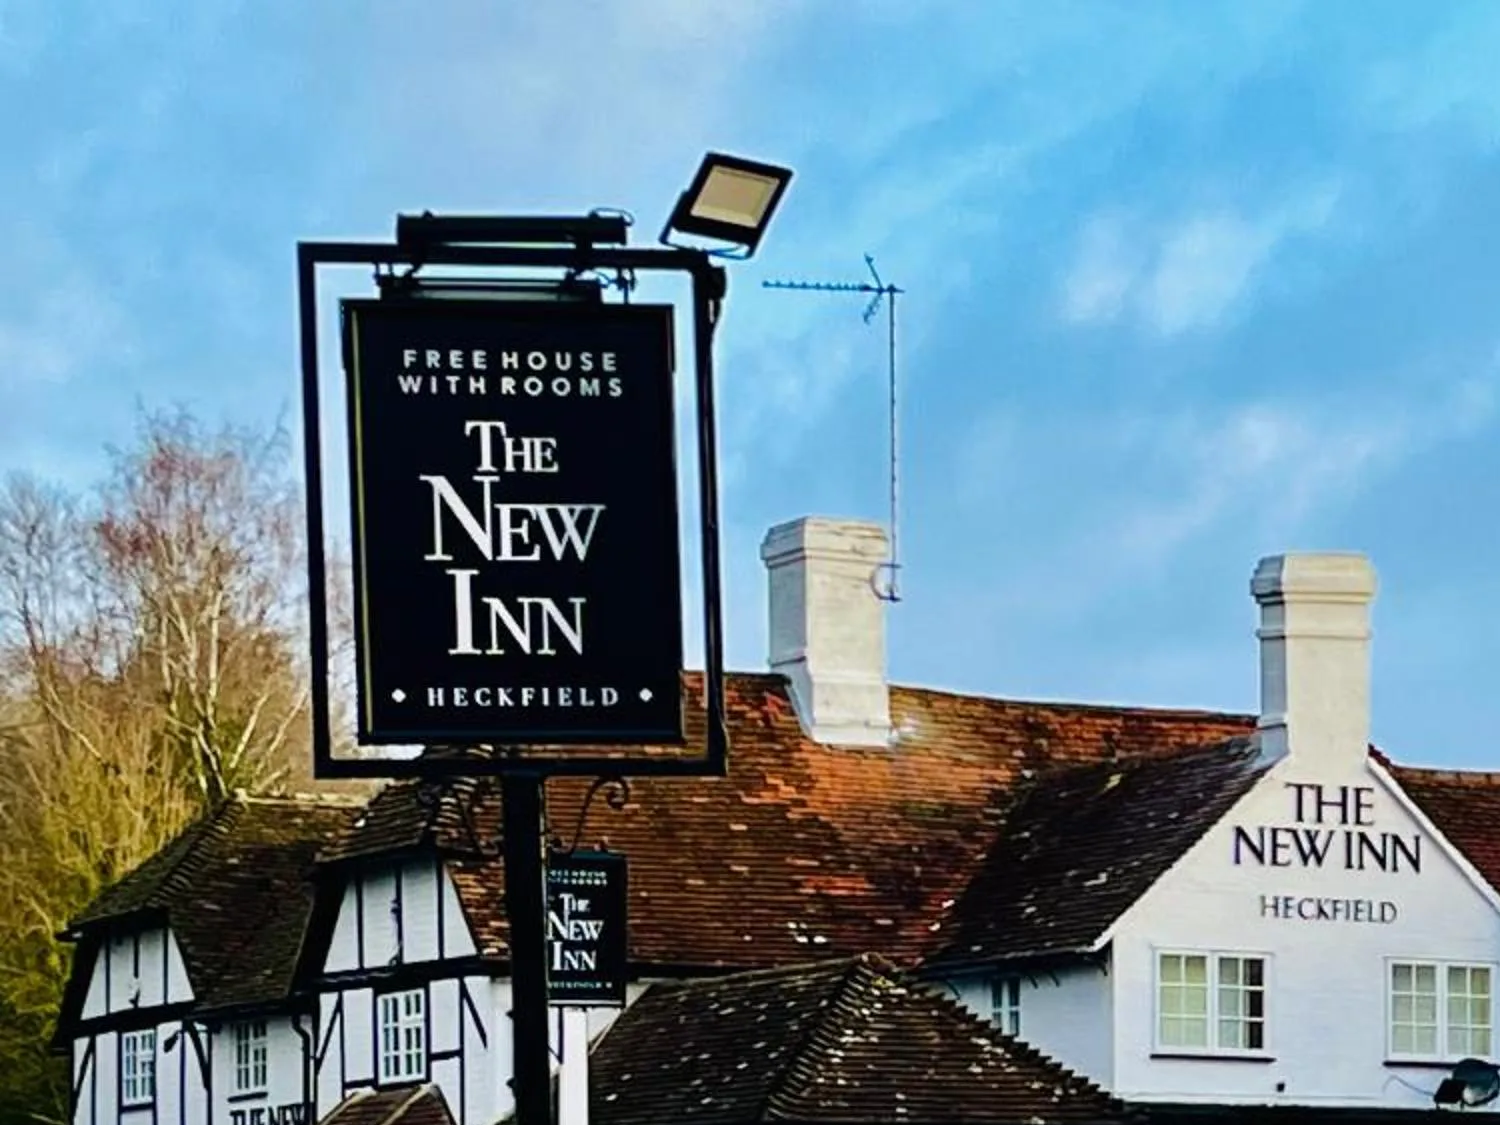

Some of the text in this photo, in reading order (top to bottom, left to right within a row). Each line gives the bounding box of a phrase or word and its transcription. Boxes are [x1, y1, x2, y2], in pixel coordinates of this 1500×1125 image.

[403, 349, 617, 372] FREE HOUSE
[397, 375, 623, 397] WITH ROOMS
[427, 687, 619, 707] HECKFIELD
[1284, 782, 1376, 826] THE
[1233, 825, 1421, 874] NEW INN
[1260, 895, 1398, 924] HECKFIELD
